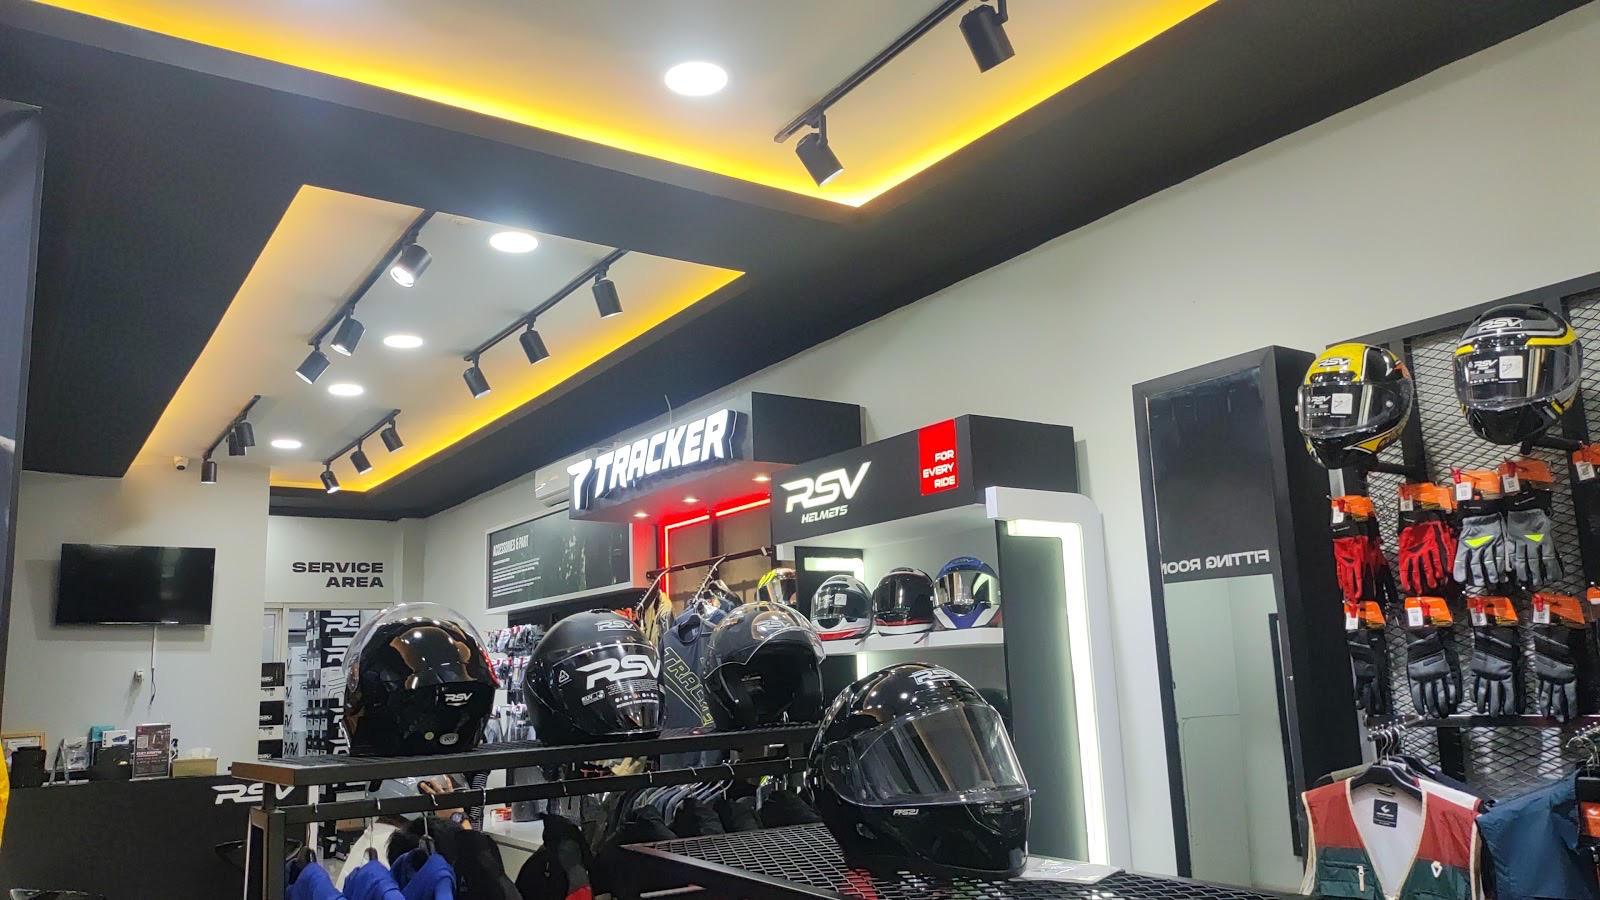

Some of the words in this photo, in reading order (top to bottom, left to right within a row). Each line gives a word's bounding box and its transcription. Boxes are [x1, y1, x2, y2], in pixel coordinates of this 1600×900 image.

[1477, 319, 1524, 333] RSV
[1317, 358, 1350, 368] RSV
[1474, 359, 1498, 368] RSV
[595, 409, 728, 498] TRACKER
[935, 450, 954, 462] FOR
[923, 462, 954, 478] EVERY
[780, 461, 872, 513] RSV
[934, 475, 956, 488] RIDE
[801, 505, 848, 523] HELMETS
[292, 562, 384, 573] SERVICE
[325, 577, 384, 587] AREA
[321, 617, 360, 632] RS
[594, 620, 637, 631] RSV
[754, 620, 791, 631] RSV
[575, 654, 661, 690] RSV
[444, 692, 474, 702] RSV
